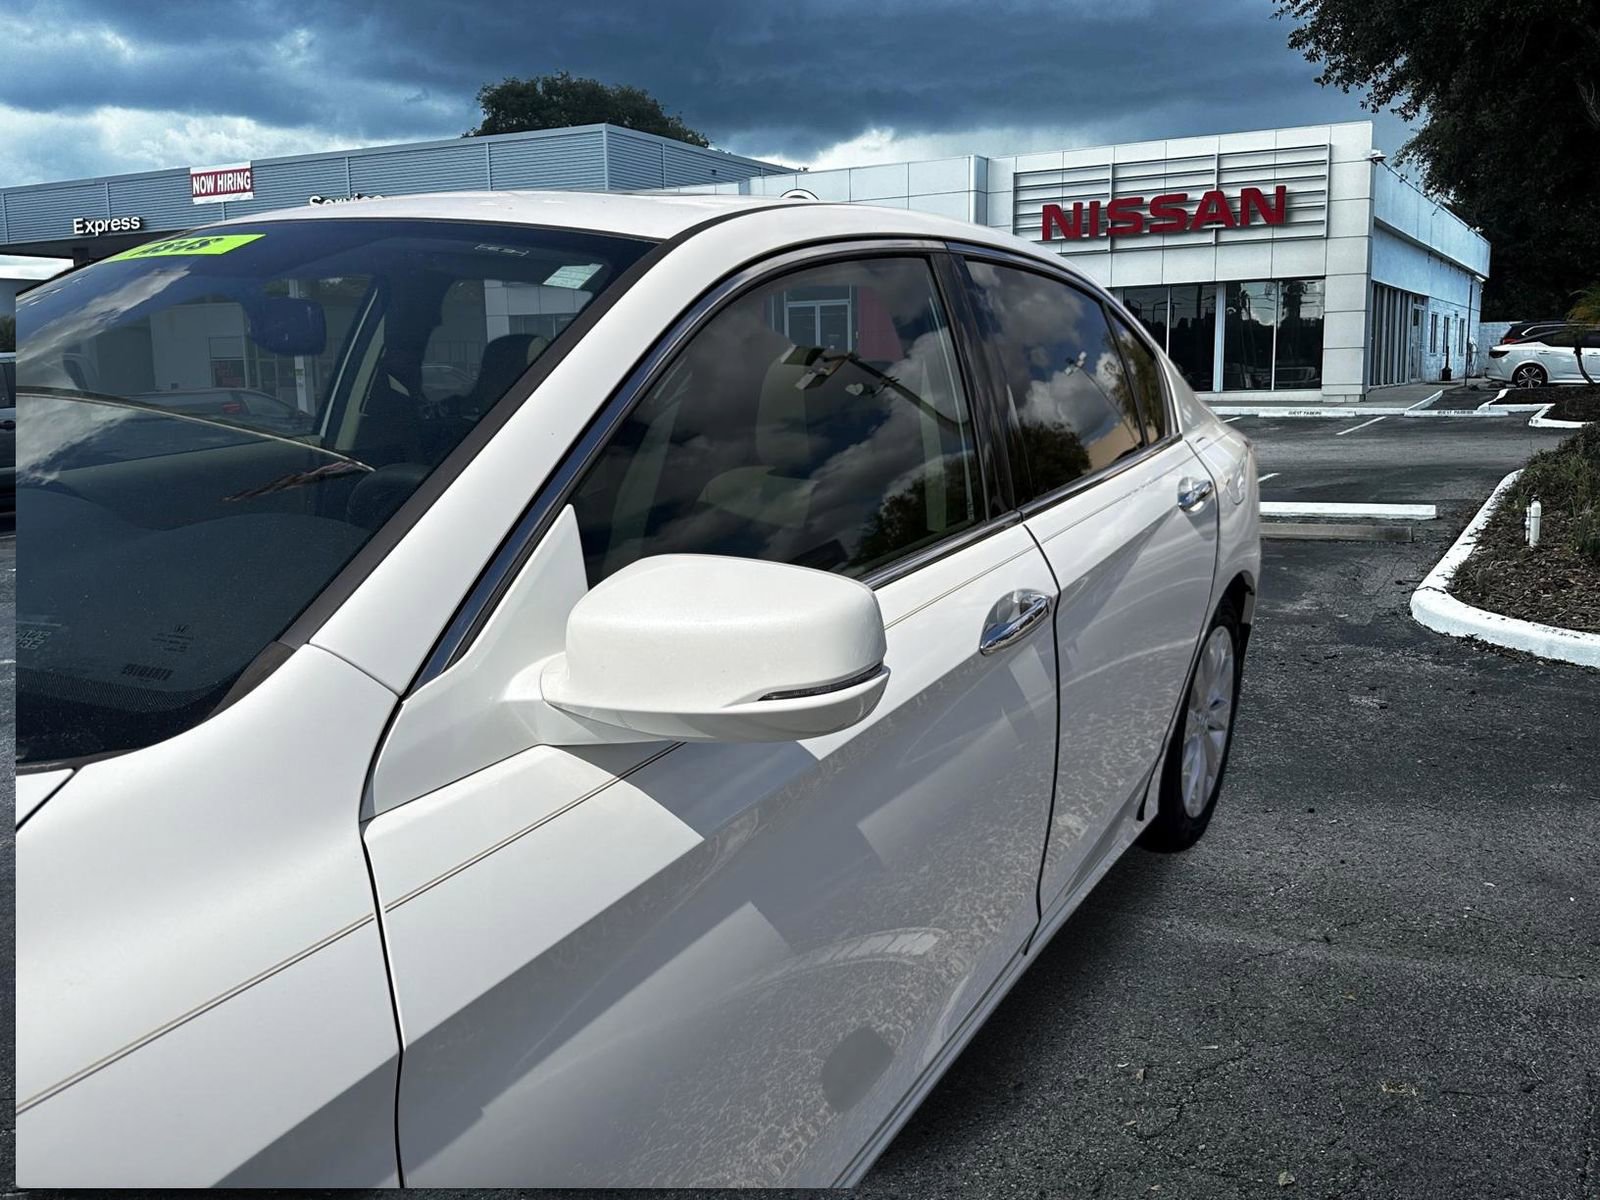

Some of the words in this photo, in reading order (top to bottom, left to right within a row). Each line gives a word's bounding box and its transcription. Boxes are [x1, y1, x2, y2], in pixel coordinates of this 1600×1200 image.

[192, 175, 215, 195] NOW
[217, 171, 251, 192] HIRING
[1042, 185, 1287, 241] NISSAN
[73, 216, 140, 236] Express
